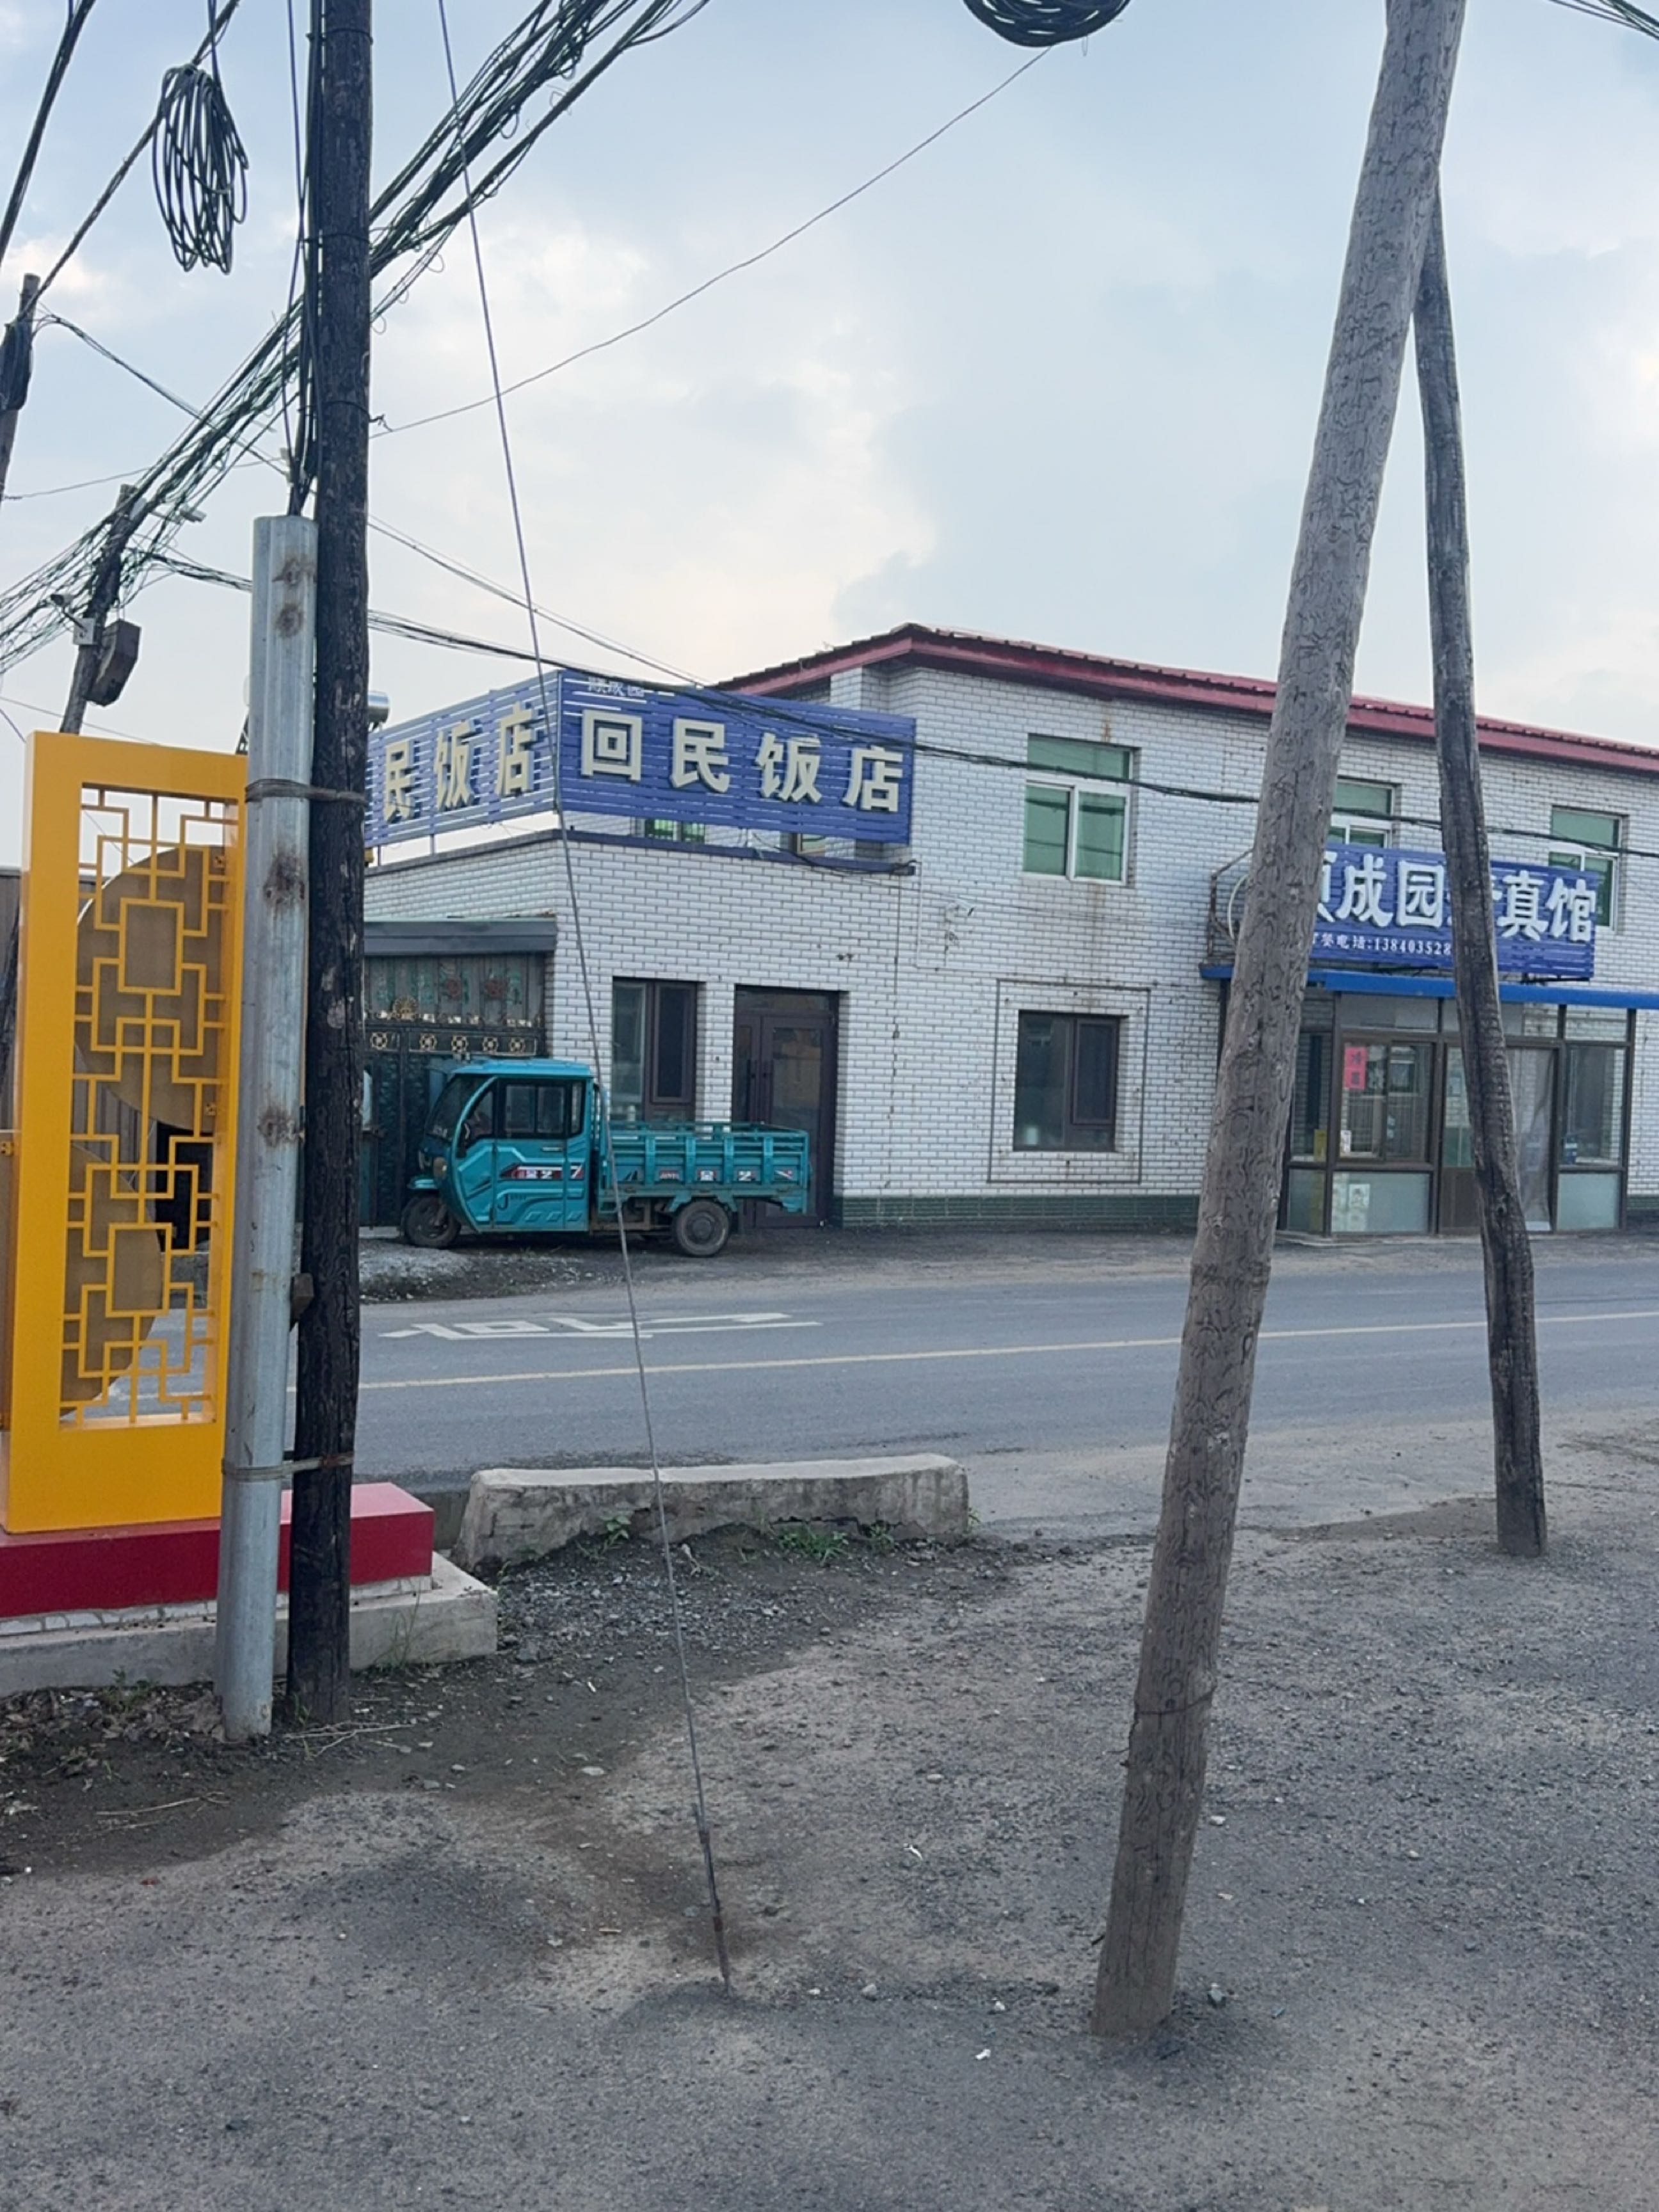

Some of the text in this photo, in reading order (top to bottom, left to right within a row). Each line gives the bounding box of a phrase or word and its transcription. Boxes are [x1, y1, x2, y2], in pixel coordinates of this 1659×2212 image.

[581, 710, 904, 812] 回民饭店
[1317, 851, 1596, 942] 成园真馆
